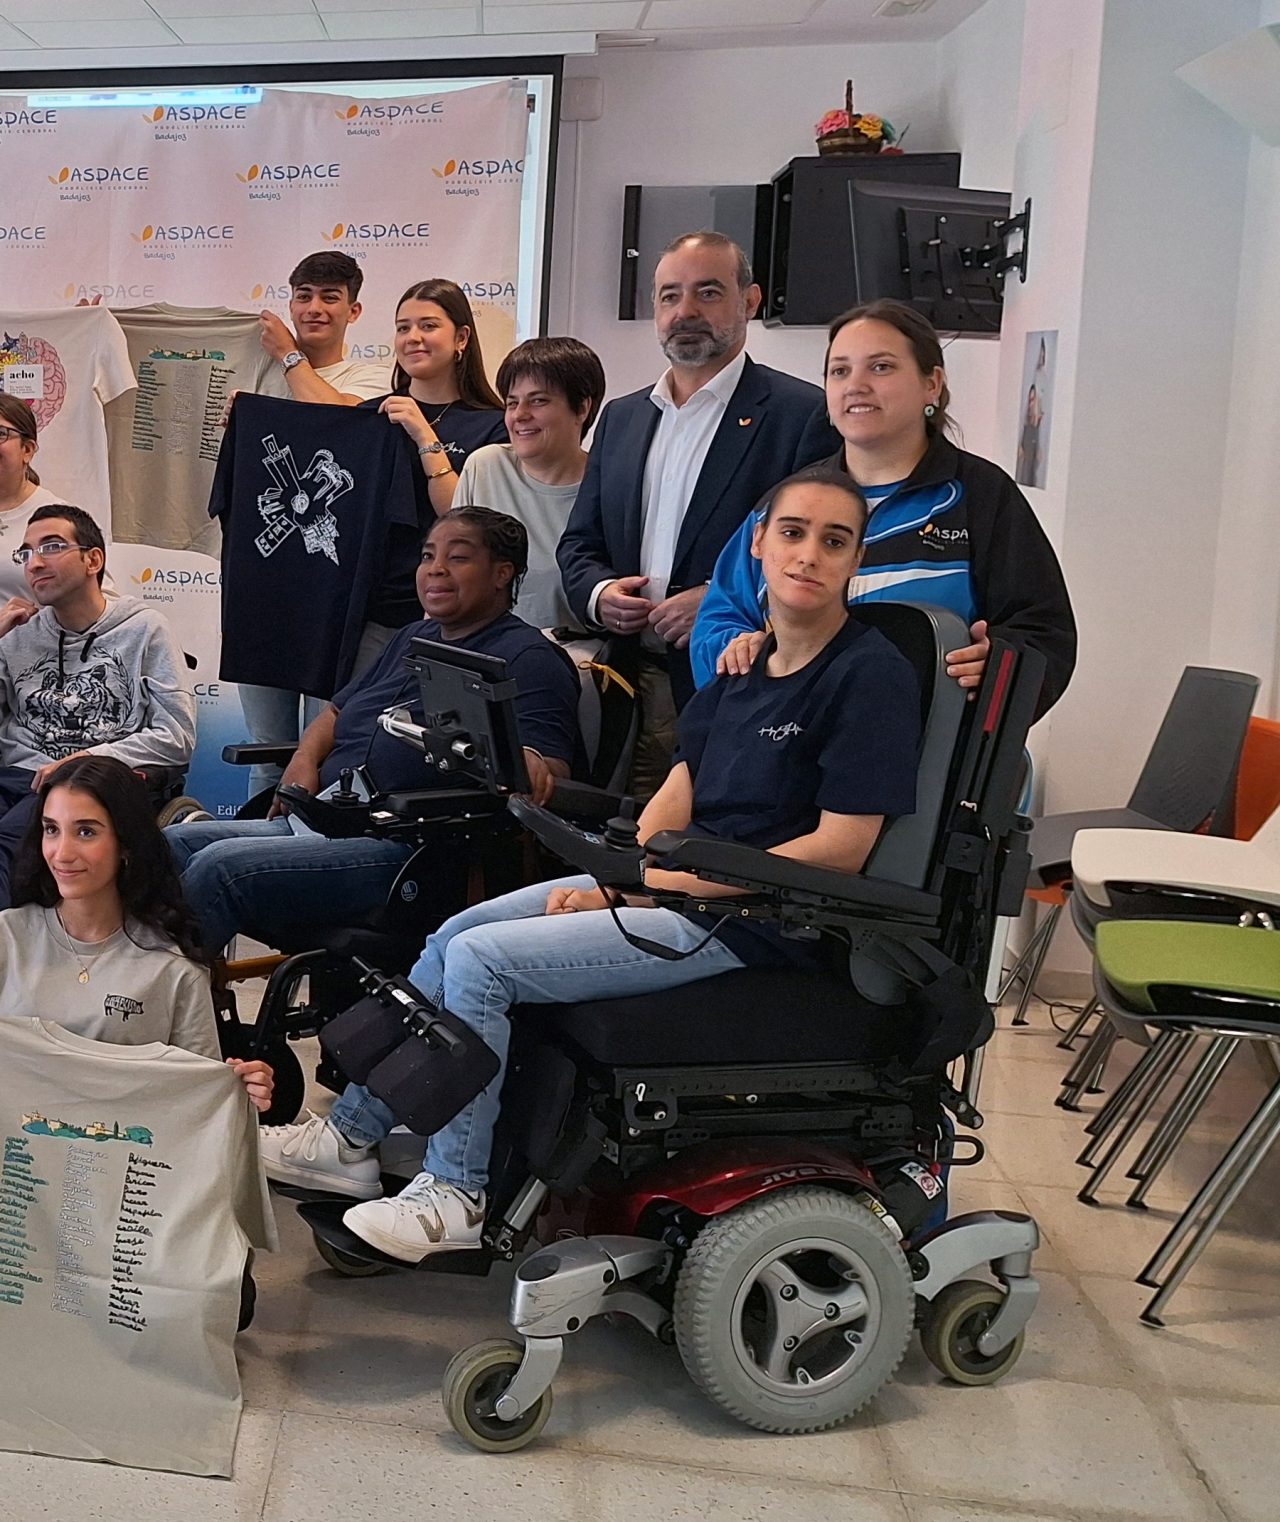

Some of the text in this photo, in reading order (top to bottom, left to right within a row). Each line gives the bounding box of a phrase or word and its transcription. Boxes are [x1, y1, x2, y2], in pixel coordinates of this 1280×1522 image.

[166, 105, 247, 123] ASPACE
[360, 101, 444, 120] ASPACE
[71, 167, 149, 184] ASPACE
[261, 164, 340, 182] ASPACE
[458, 159, 524, 178] ASPAC
[155, 225, 234, 242] ASPACE
[346, 223, 430, 241] ASPACE
[461, 282, 516, 300] ASPA
[9, 369, 35, 380] acho
[932, 527, 969, 540] ASPA
[154, 569, 222, 586] ASPAC
